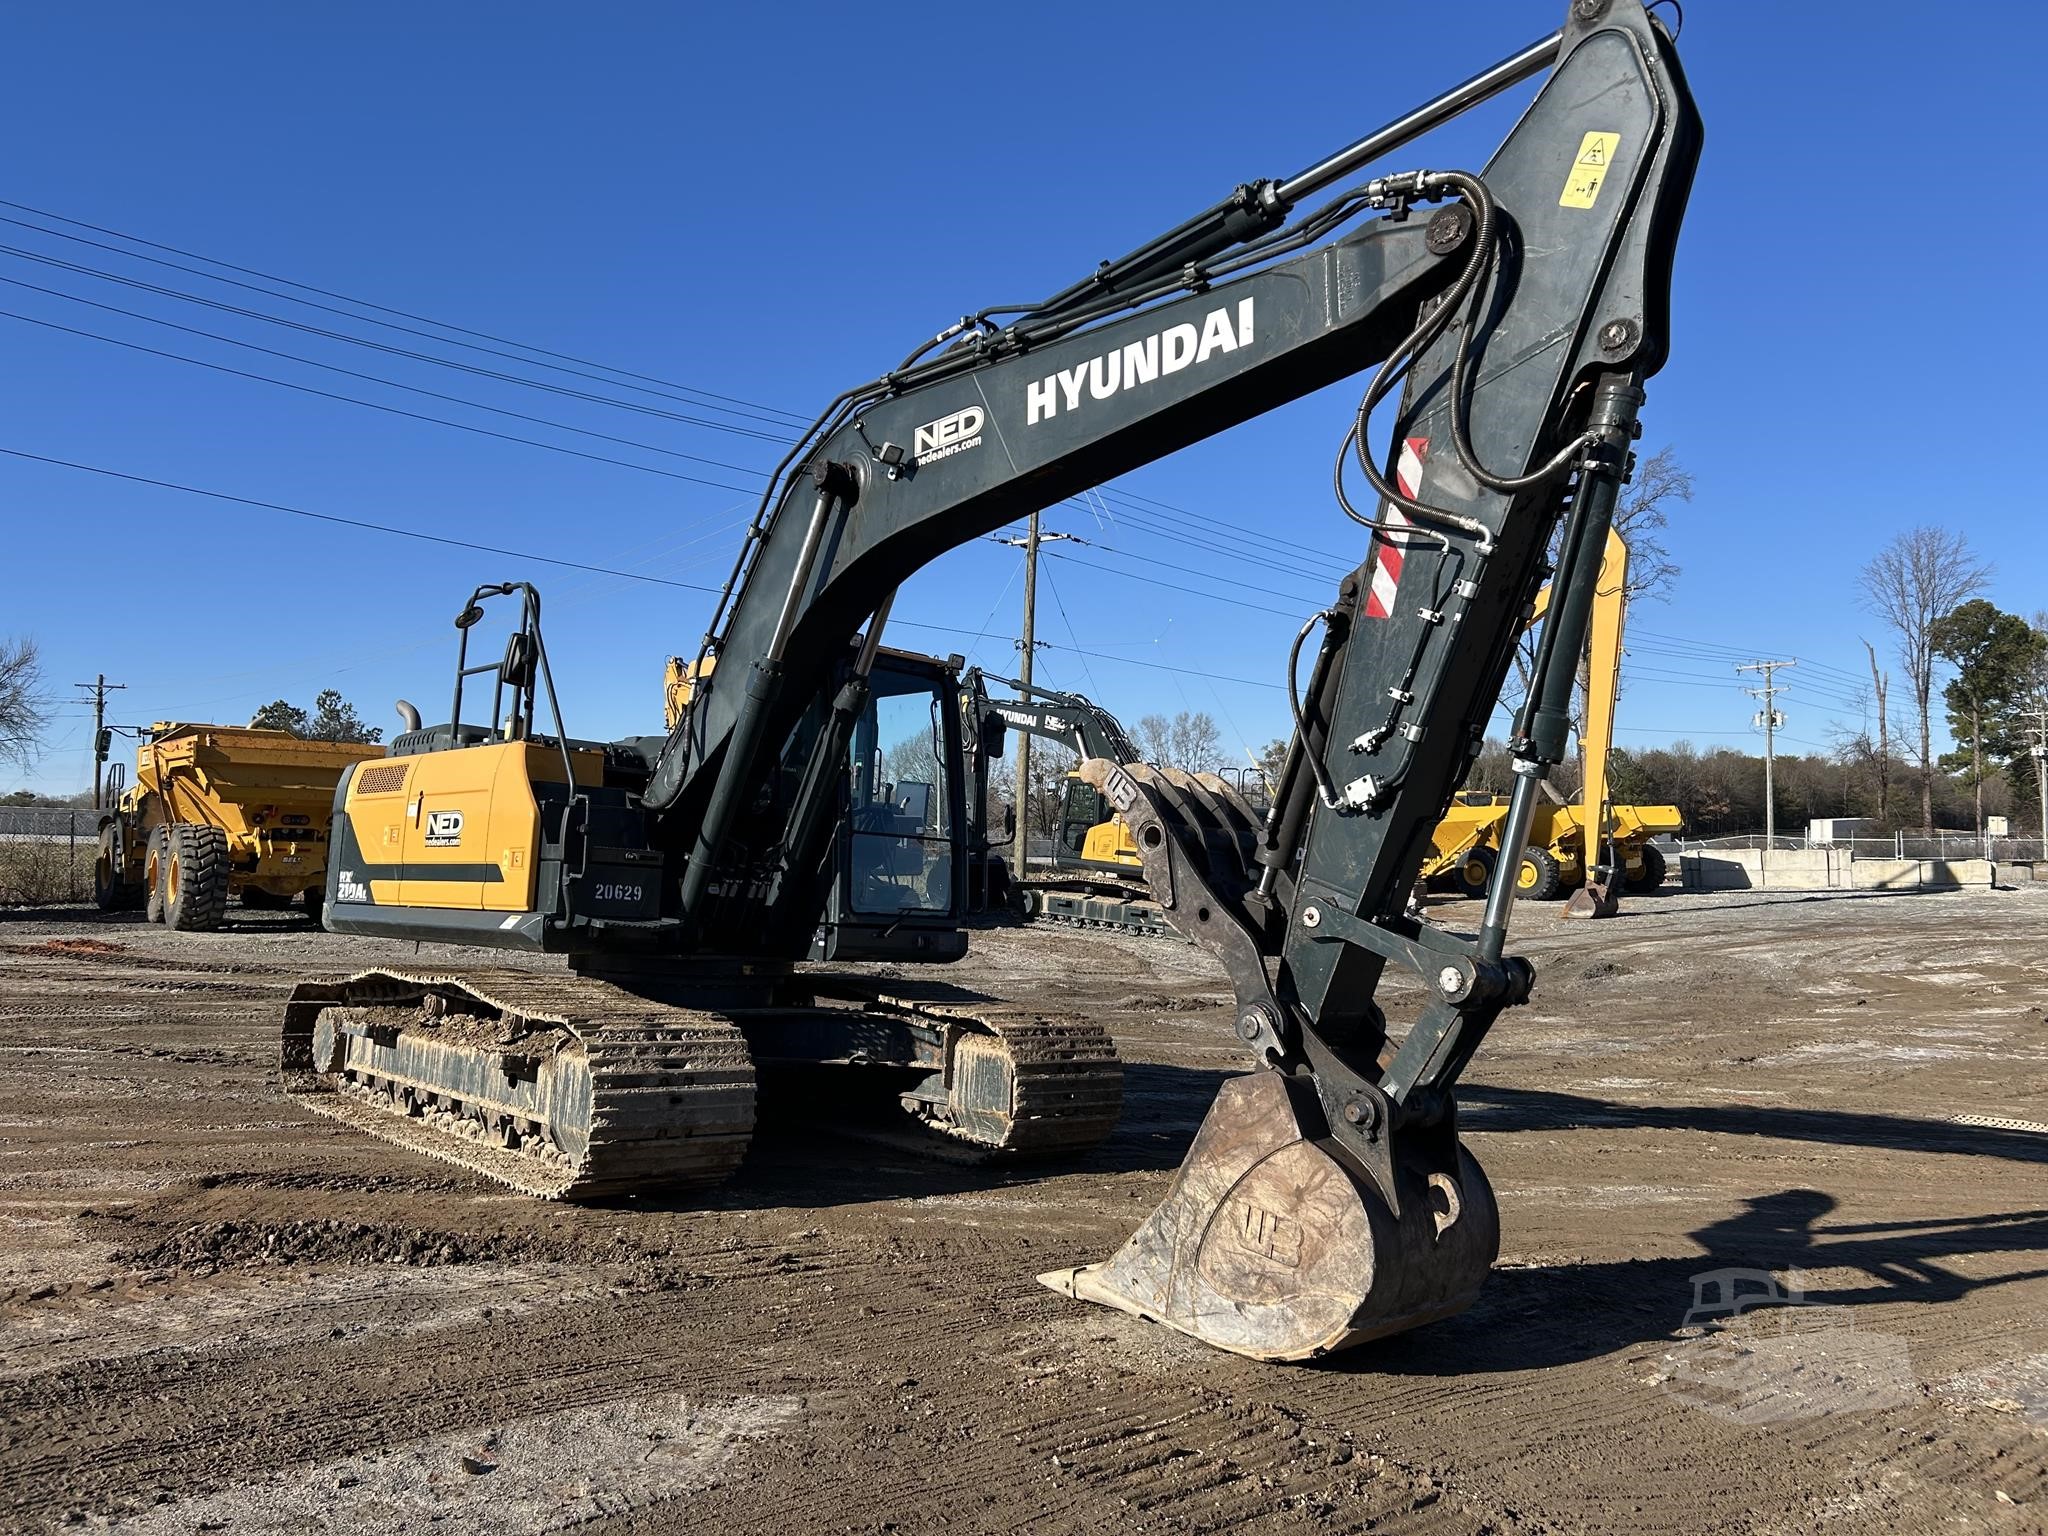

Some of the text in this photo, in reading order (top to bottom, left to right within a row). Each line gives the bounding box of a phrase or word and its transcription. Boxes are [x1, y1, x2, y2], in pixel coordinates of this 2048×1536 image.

[1027, 297, 1254, 426] HYUNDAI
[915, 406, 984, 457] NED
[426, 811, 464, 837] NED
[339, 871, 353, 882] HX
[595, 884, 642, 900] 20629
